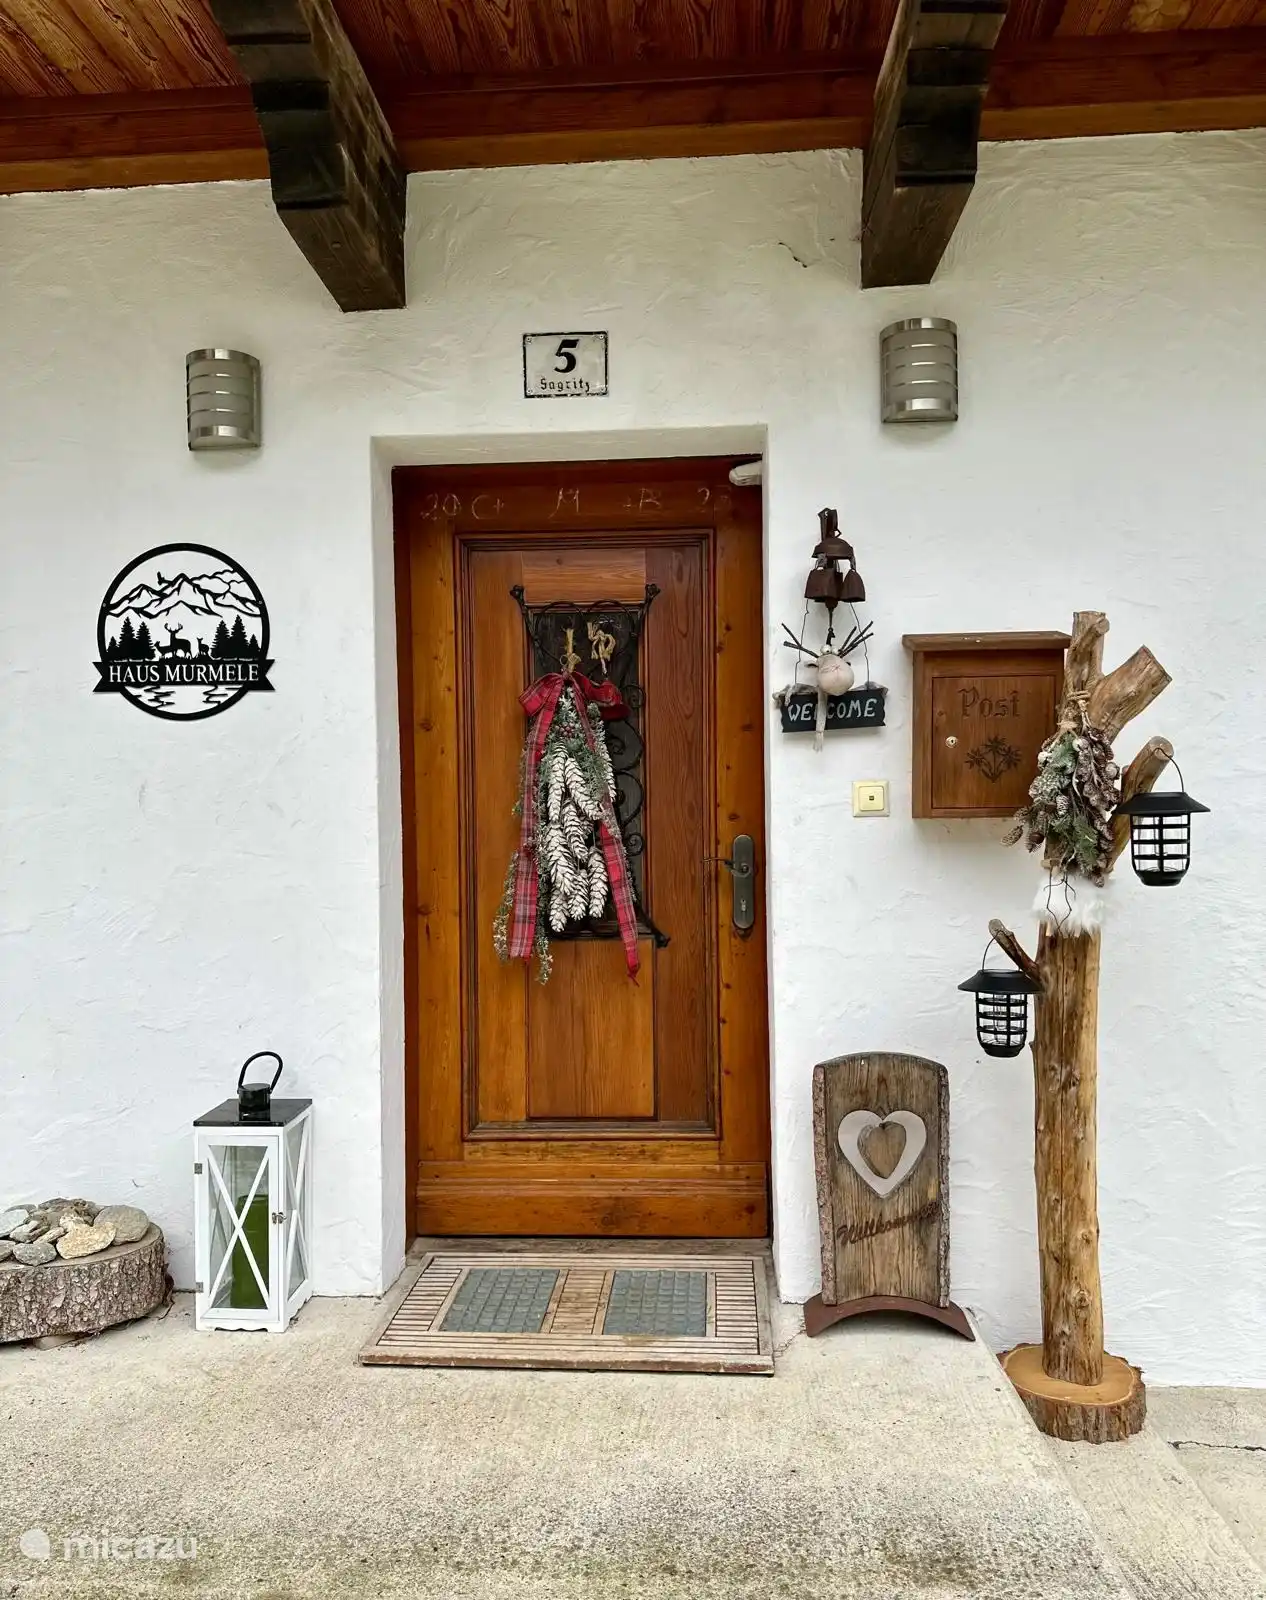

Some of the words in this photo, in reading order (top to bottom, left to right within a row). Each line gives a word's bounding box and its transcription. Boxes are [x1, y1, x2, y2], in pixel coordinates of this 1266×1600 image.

[553, 339, 580, 373] 5
[540, 377, 590, 393] Sagritz
[109, 664, 160, 683] HAUS
[165, 663, 260, 684] MURMELE
[957, 685, 1021, 718] Post
